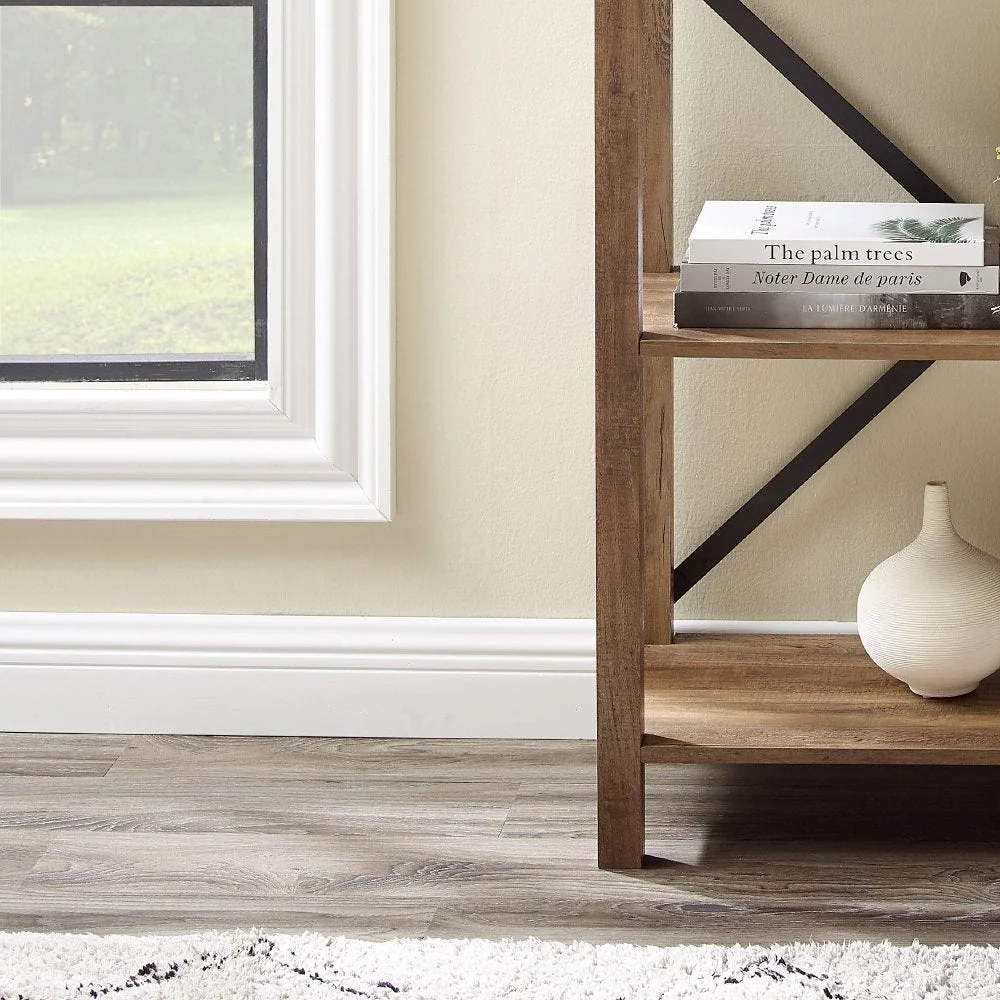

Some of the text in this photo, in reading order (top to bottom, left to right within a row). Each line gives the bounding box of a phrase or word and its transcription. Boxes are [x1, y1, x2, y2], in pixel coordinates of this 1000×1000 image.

[764, 244, 914, 265] The palm trees
[751, 271, 922, 287] Noter Dame de paris
[802, 304, 813, 313] LA
